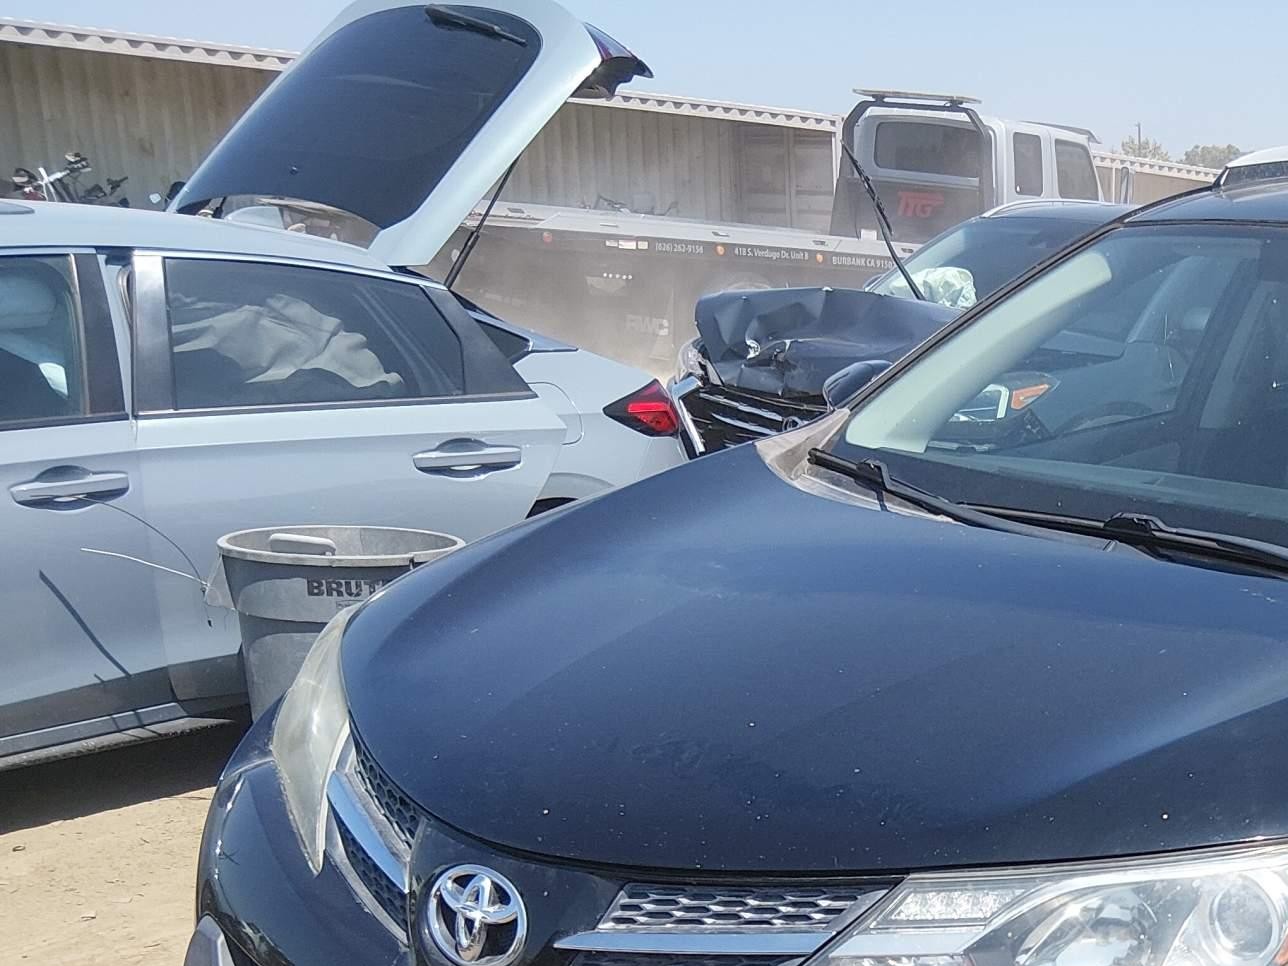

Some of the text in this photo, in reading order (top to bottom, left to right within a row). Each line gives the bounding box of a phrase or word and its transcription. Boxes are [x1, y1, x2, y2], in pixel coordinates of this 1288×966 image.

[754, 249, 780, 260] Verdugo
[790, 252, 804, 261] Unit
[832, 255, 866, 267] BURBANK
[866, 257, 876, 268] CA
